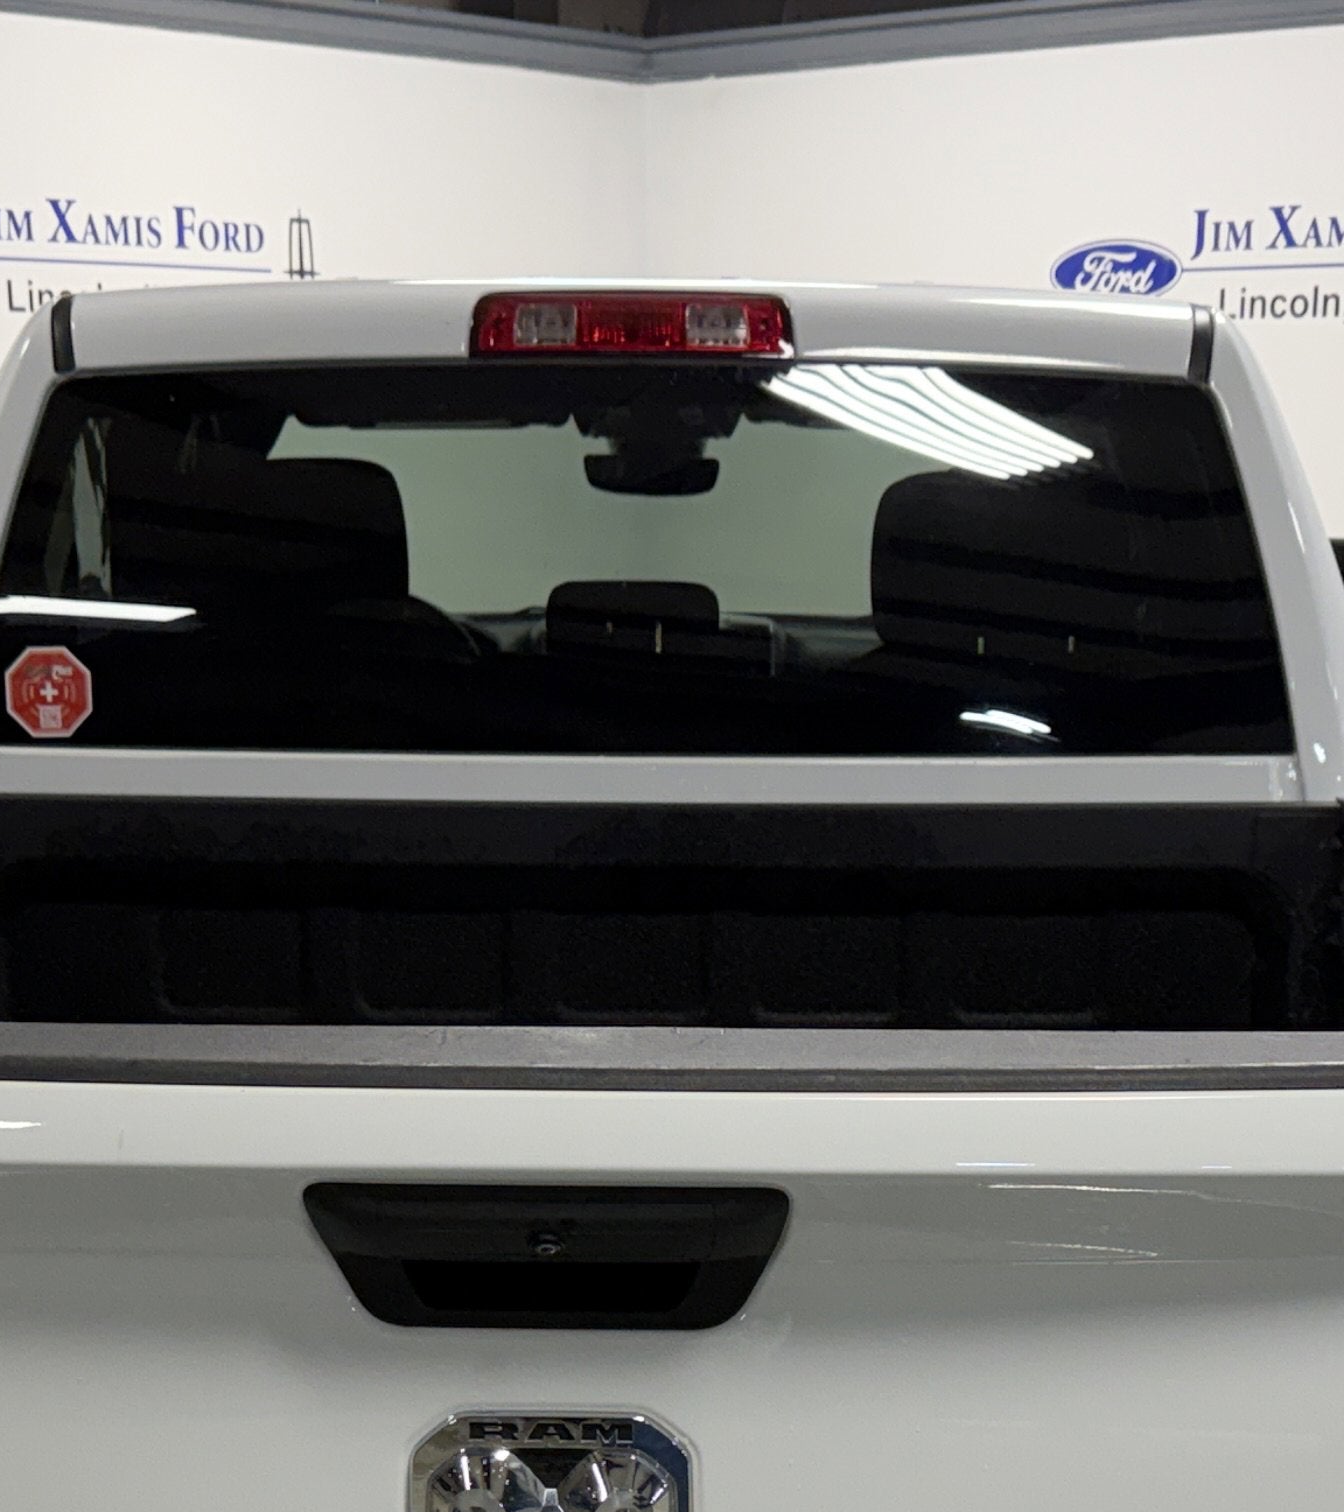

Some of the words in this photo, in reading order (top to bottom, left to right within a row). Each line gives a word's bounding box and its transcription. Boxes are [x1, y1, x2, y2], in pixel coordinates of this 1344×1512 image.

[45, 198, 163, 249] XAMIS
[173, 205, 265, 253] FORD
[1191, 209, 1254, 261] JIM
[1075, 252, 1156, 294] Ford
[468, 1421, 635, 1444] RAM
